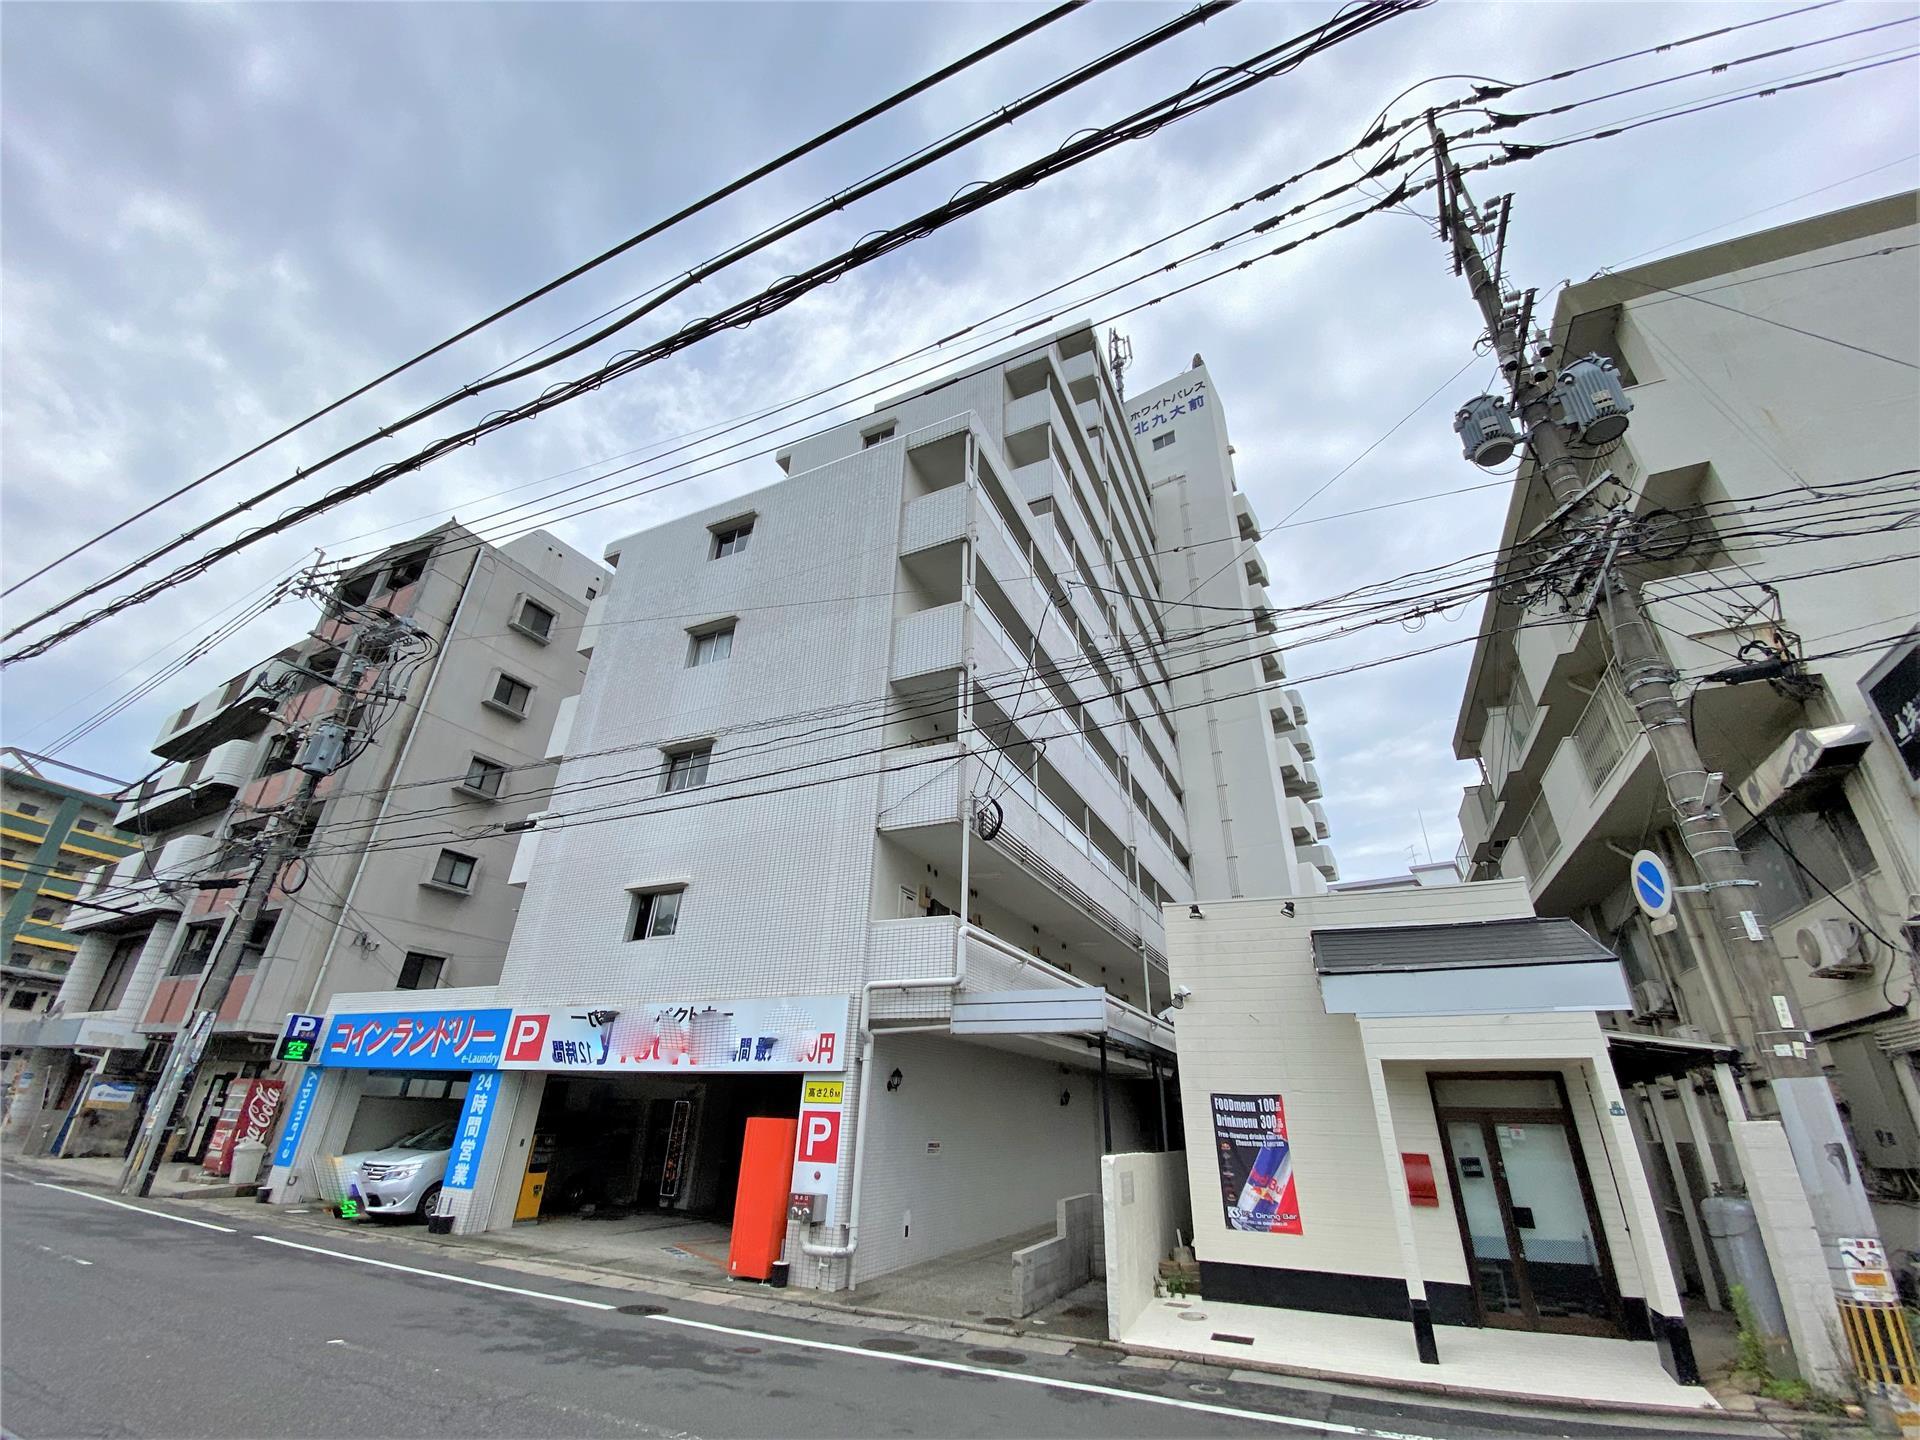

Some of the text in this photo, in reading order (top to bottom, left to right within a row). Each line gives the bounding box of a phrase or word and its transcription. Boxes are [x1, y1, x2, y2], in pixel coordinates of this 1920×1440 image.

[1134, 395, 1204, 436] 北九大前
[292, 1017, 316, 1037] P
[331, 1016, 496, 1058] コインランドリー
[512, 1020, 540, 1056] P
[284, 1040, 308, 1060] 空
[461, 1052, 499, 1066] e-Laundry
[281, 1071, 318, 1159] e-Laundry
[451, 1073, 493, 1186] 24時間営業
[1216, 1113, 1258, 1129] Drinkmenu
[1260, 1114, 1276, 1129] 300
[806, 1117, 832, 1157] P
[1255, 1212, 1281, 1222] Dining
[1282, 1212, 1297, 1220] Bar
